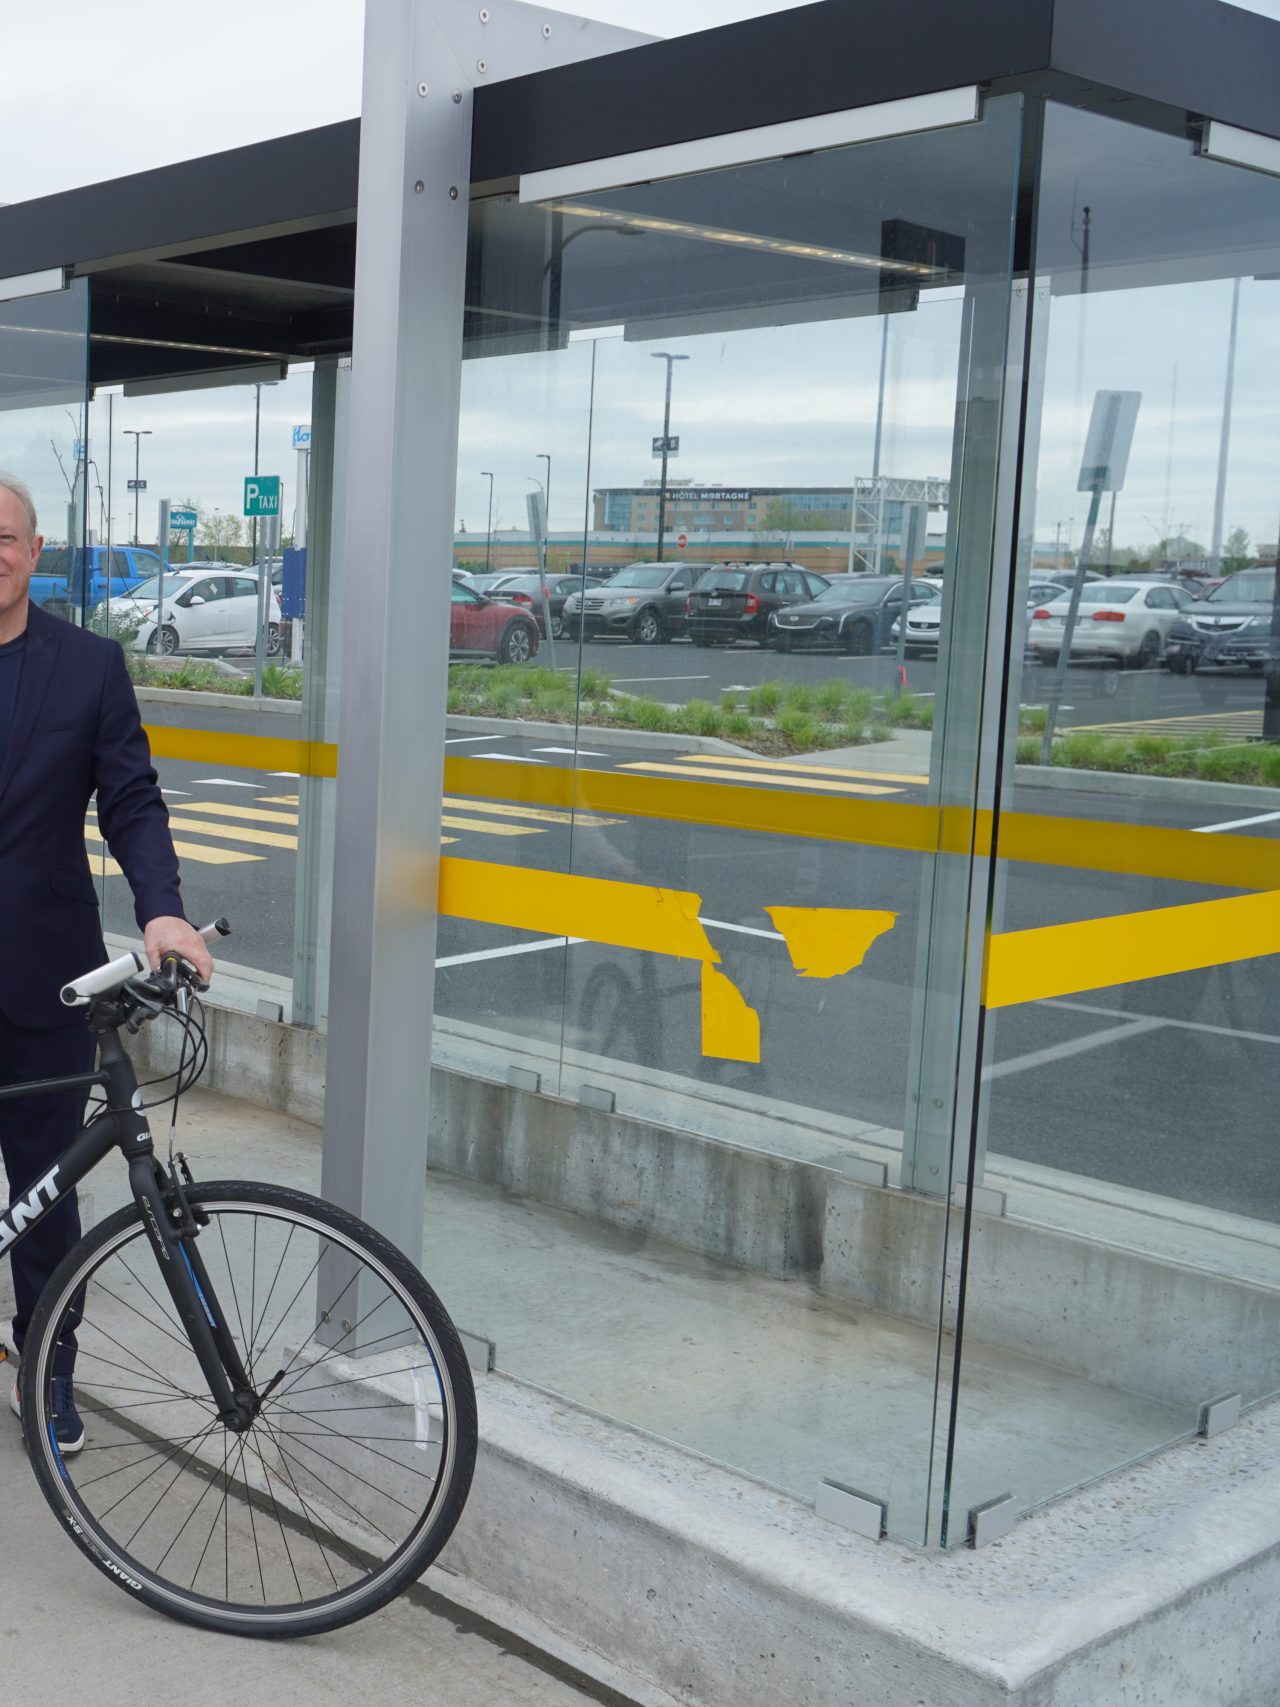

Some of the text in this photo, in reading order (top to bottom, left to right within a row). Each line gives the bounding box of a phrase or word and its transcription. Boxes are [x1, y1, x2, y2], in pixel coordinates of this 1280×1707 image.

[246, 483, 277, 510] P TAXI
[672, 490, 750, 500] HÔTEL MORTAGNE
[102, 1559, 143, 1591] GIANT
